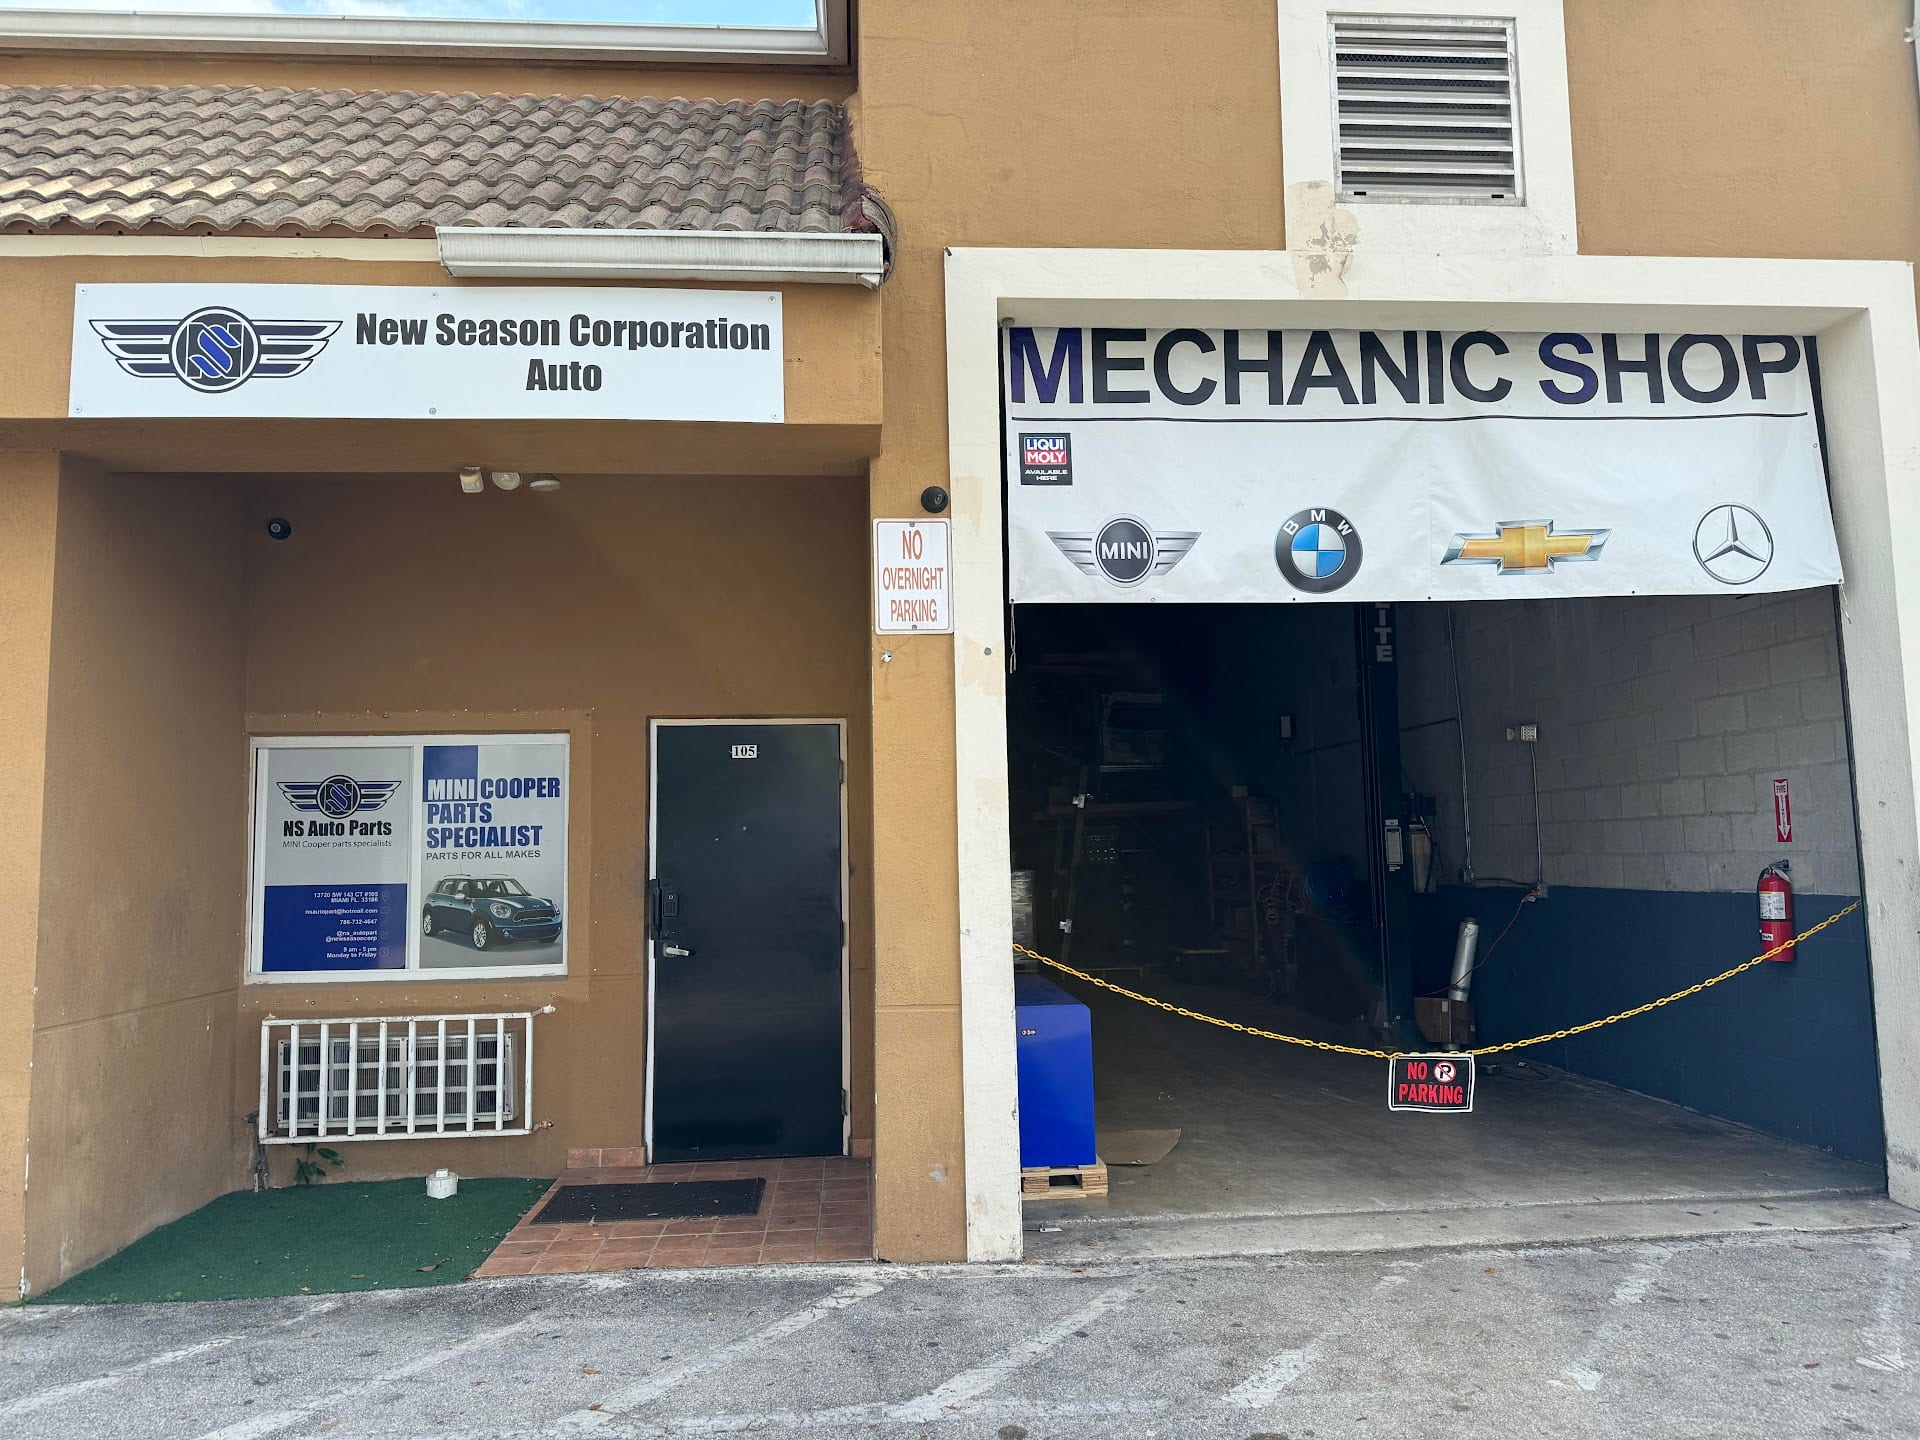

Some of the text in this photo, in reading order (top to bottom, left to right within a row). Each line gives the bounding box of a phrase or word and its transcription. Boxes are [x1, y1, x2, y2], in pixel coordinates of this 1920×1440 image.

[356, 313, 770, 351] New Season Corporation
[525, 358, 602, 392] Auto
[1009, 327, 1801, 406] MECHANIC SHOP
[1026, 438, 1064, 451] LIQUI
[1027, 451, 1065, 464] MOLY
[1282, 509, 1353, 536] BMW
[902, 529, 923, 560] NO
[1101, 541, 1148, 560] MINI
[882, 566, 944, 591] OVERNIGHT
[890, 598, 938, 623] PARKING
[733, 745, 755, 757] 105
[427, 777, 561, 801] MINI COOPER
[427, 802, 493, 825] PARTS
[283, 819, 392, 837] NS Auto Parts
[426, 825, 543, 849] SPECIALIST
[282, 839, 392, 850] MINI Cooper parts specialists
[426, 850, 541, 861] PARTS FOR ALL MAKES
[358, 951, 377, 959] Friday
[1407, 1061, 1428, 1080] NO
[1398, 1083, 1464, 1105] PARKING
